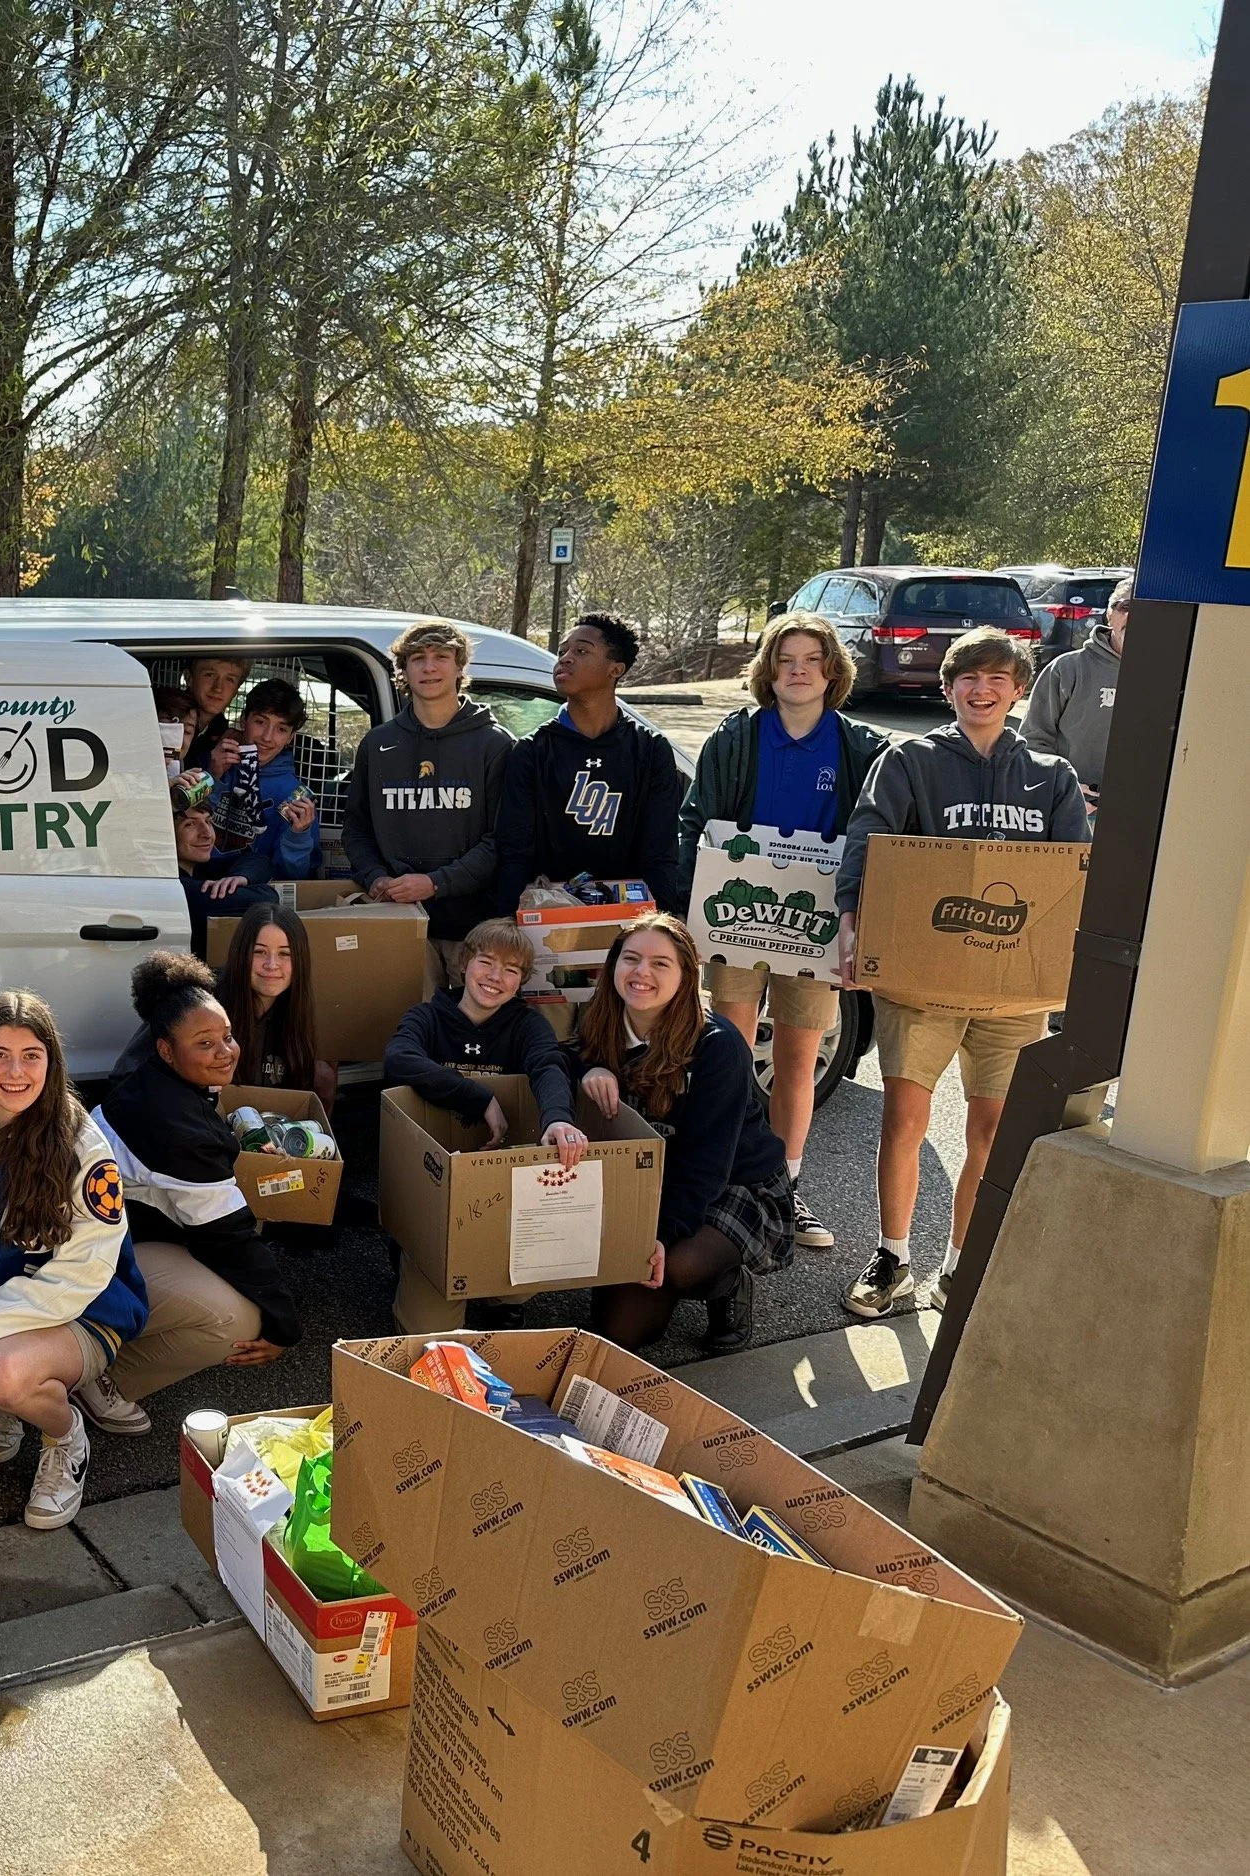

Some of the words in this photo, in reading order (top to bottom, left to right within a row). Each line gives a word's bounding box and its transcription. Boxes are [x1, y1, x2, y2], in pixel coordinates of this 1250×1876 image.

[382, 787, 472, 810] TITANS
[565, 771, 623, 836] LOA
[816, 783, 833, 792] LOA
[767, 852, 797, 862] COOLED
[769, 841, 801, 851] PRODUCE
[815, 857, 841, 867] ORCED
[890, 839, 953, 850] VENDING
[962, 843, 969, 851] &
[979, 844, 1074, 855] FOODSERVICE
[714, 901, 831, 937] DeWITT
[732, 922, 766, 933] Farm
[719, 933, 766, 948] PREMIUM
[769, 941, 814, 955] PEPPERS
[963, 935, 994, 950] Good
[996, 937, 1021, 953] fun!
[471, 1154, 525, 1167] VENDING
[532, 1153, 539, 1161] &
[546, 1147, 631, 1161] FOERVICE
[395, 1458, 443, 1494] ssww.com
[472, 1501, 524, 1538] ssww.com
[553, 1548, 611, 1586] ssww.com
[335, 1615, 360, 1627] Tyson
[643, 1602, 708, 1640] ssww.com
[484, 1638, 533, 1671] ssww.com
[746, 1640, 814, 1693] ssww.com
[417, 1641, 442, 1681] andejas
[442, 1674, 479, 1727] Escolares
[842, 1665, 910, 1715] ssww.com
[561, 1695, 617, 1729] ssww.com
[931, 1685, 994, 1734] ssww.com
[435, 1697, 487, 1768] Compartimientos
[440, 1738, 465, 1776] (4/125)
[457, 1744, 468, 1761] cm
[490, 1784, 503, 1803] cm
[648, 1757, 715, 1793] ssww.com
[424, 1769, 470, 1836] Compartiments
[438, 1756, 461, 1794] Repas
[462, 1789, 501, 1843] Scolaires
[437, 1816, 460, 1853] (4/125)
[456, 1829, 468, 1846] cm
[630, 1828, 651, 1865] 4
[739, 1838, 833, 1866] PACTIV
[735, 1862, 755, 1873] Lake
[737, 1852, 784, 1870] Foodservice
[788, 1865, 807, 1876] Food
